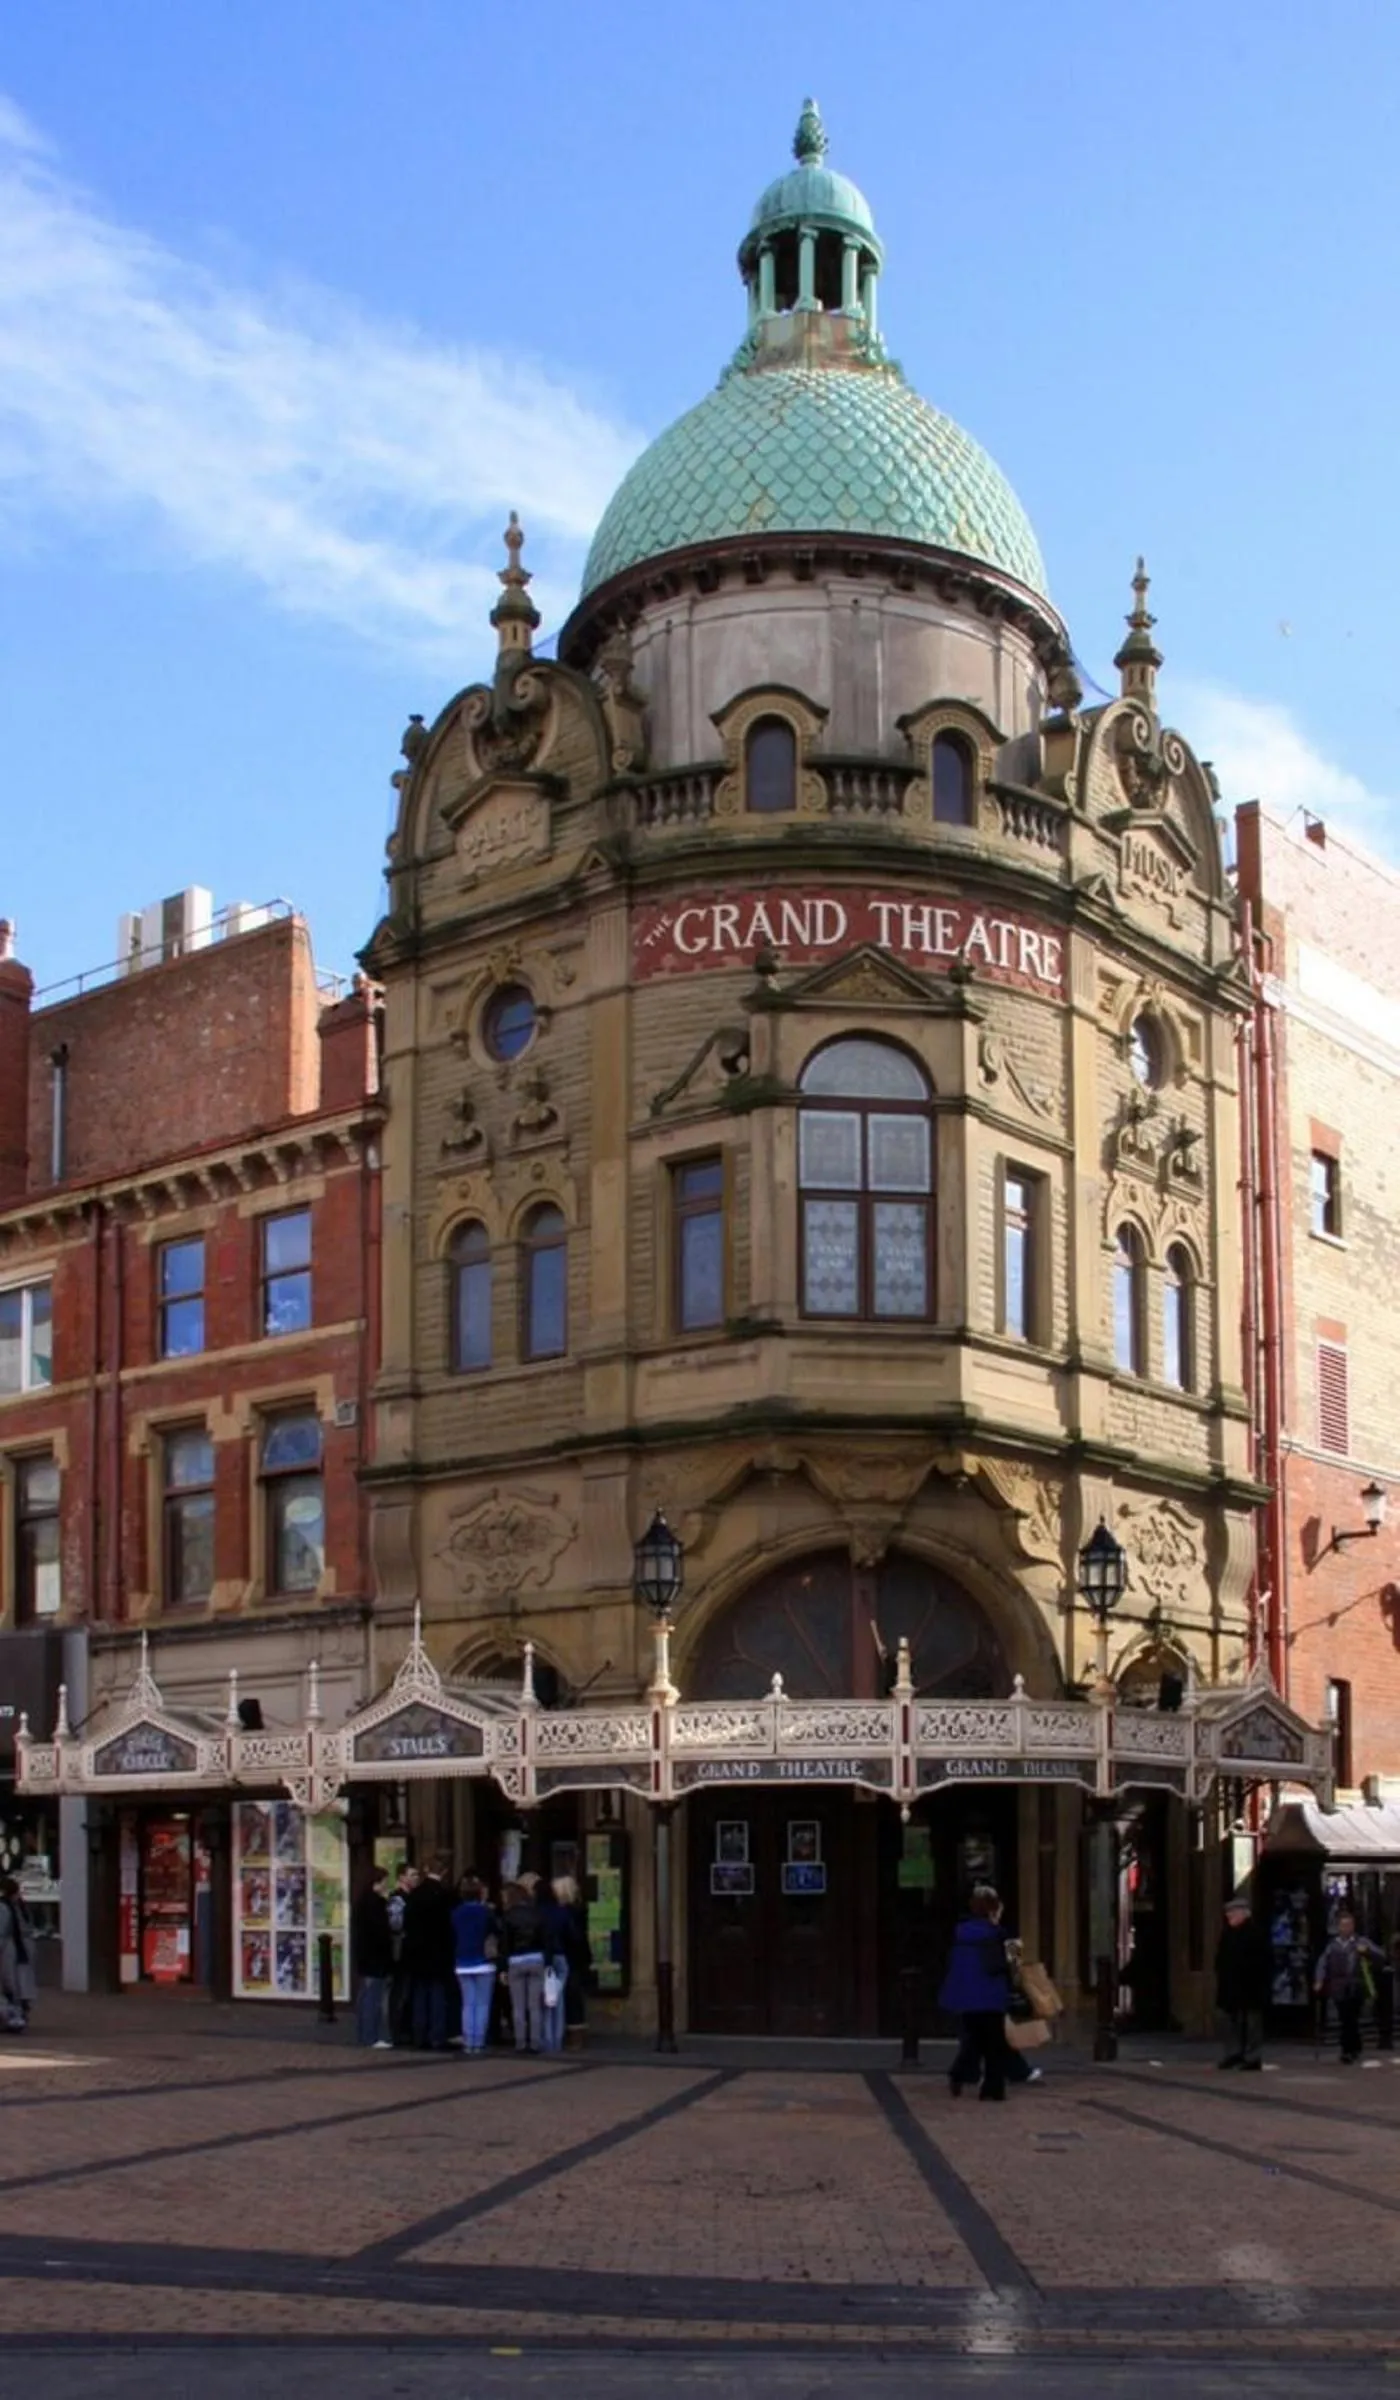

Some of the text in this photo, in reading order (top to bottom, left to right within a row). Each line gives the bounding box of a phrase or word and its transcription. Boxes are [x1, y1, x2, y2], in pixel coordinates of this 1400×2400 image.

[642, 898, 1063, 984] THE GRAND THEATRE
[390, 1735, 447, 1755] STALLS
[697, 1760, 864, 1777] GRAND THEATRE
[945, 1759, 1008, 1775] GRAND
